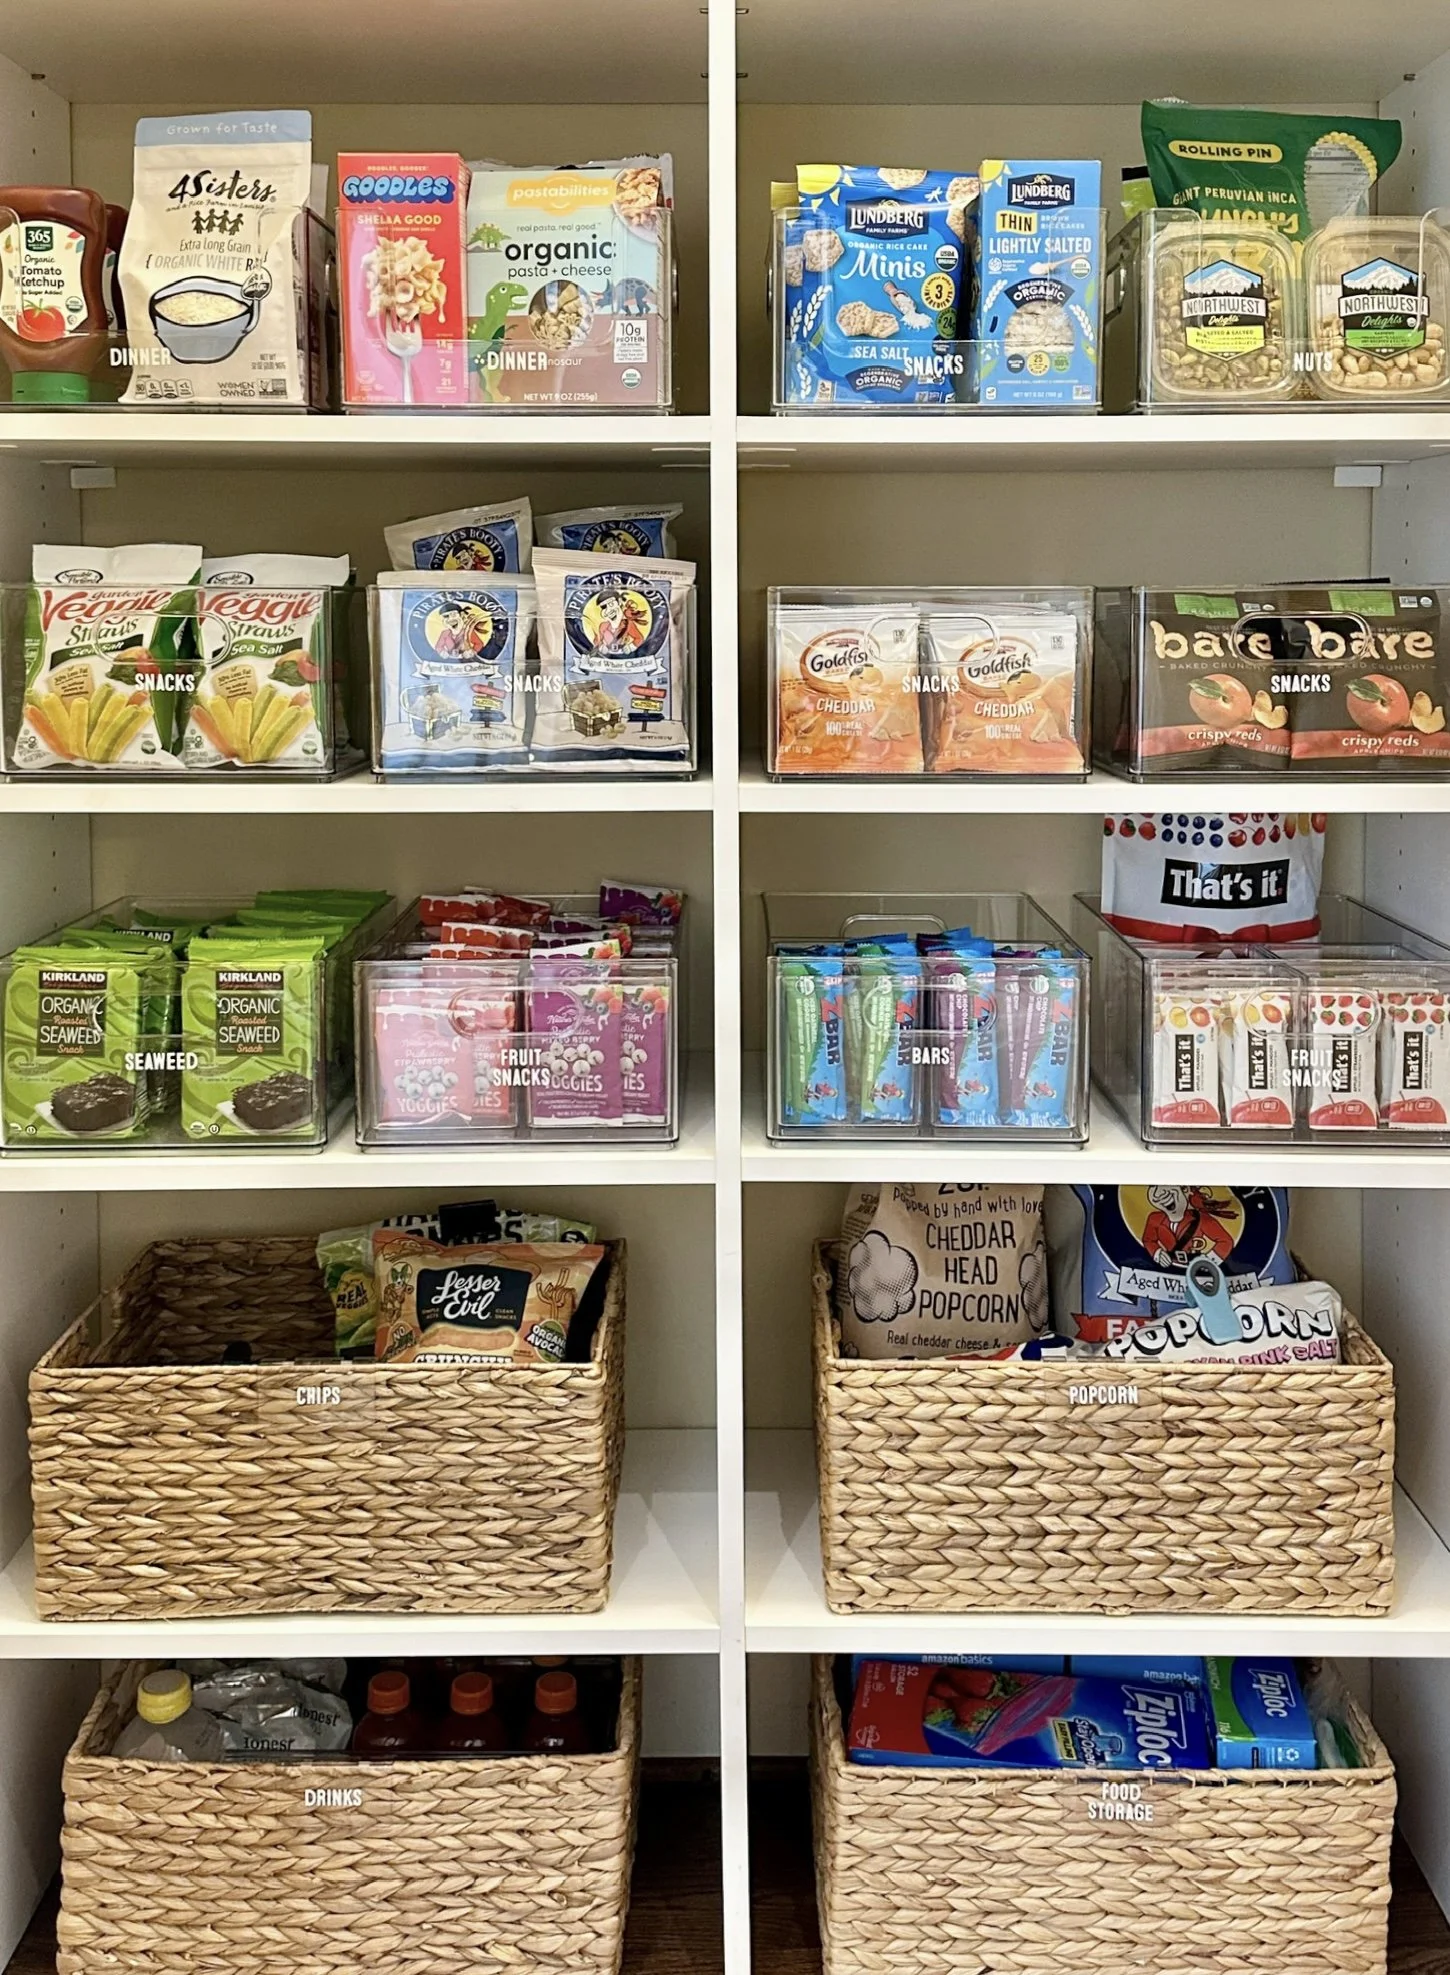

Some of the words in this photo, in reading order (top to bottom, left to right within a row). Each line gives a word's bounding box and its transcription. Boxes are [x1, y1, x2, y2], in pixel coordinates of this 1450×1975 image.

[167, 124, 210, 134] Grown
[216, 122, 239, 133] for
[242, 121, 278, 133] Taste
[1179, 145, 1242, 158] ROLLING
[1247, 147, 1272, 158] PIN
[342, 174, 455, 203] GOODLES
[513, 184, 610, 200] pastabilities
[1011, 184, 1071, 203] LUNDBERG
[1173, 186, 1201, 206] GIANT
[1205, 187, 1264, 204] PERUVIAN
[1268, 191, 1297, 204] INCA
[404, 214, 442, 225] GOOD
[516, 223, 532, 232] real
[558, 223, 574, 232] real
[850, 207, 924, 230] LUNDBERG
[1000, 214, 1033, 232] THIN
[28, 230, 51, 244] 365
[180, 238, 200, 252] Extra
[203, 238, 225, 252] Long
[227, 239, 252, 252] Grain
[848, 242, 884, 250] ORGANIC
[886, 242, 904, 250] RICE
[989, 238, 1042, 254] LIGHTLY
[1044, 238, 1092, 254] SALTED
[24, 254, 56, 264] Organic
[505, 234, 613, 266] organic
[21, 266, 62, 276] Tomato
[154, 254, 202, 269] ORGANIC
[206, 256, 243, 272] WHITE
[508, 266, 548, 279] pasta
[561, 264, 612, 276] cheese
[840, 250, 926, 280] Minis
[21, 276, 65, 289] Ketchup
[935, 284, 943, 300] 3
[620, 322, 642, 336] 10g
[1361, 314, 1402, 329] Delights
[110, 348, 172, 366] DINNER
[487, 352, 548, 370] DINNER
[854, 346, 878, 359] SEA
[880, 346, 910, 360] SALT
[1293, 352, 1333, 372] NUTS
[904, 354, 964, 377] SNACKS
[218, 381, 255, 389] WOMEN
[856, 376, 904, 386] ORGANIC
[220, 390, 256, 398] OWNED
[524, 393, 538, 401] NET
[540, 393, 552, 401] WT
[560, 393, 572, 401] OZ
[574, 392, 598, 402] (255g)
[470, 528, 504, 557] BOOTY
[620, 522, 650, 546] BOOTY
[568, 574, 622, 611] PIRATE'S
[43, 590, 172, 632] Veggie
[197, 591, 322, 627] Veggie
[412, 590, 464, 619] PIRATE'S
[222, 621, 296, 641] Straws
[1150, 620, 1274, 660] bare
[1304, 620, 1435, 660] bare
[968, 652, 1032, 678] Goldfish
[1170, 662, 1209, 670] BAKED
[1372, 662, 1426, 671] CRUNCHY
[134, 673, 195, 692] SNACKS
[504, 675, 561, 692] SNACKS
[902, 676, 960, 693] SNACKS
[1270, 674, 1331, 693] SNACKS
[816, 698, 876, 714] CHEDDAR
[974, 702, 1036, 718] CHEDDAR
[1188, 730, 1232, 742] crispy
[1236, 730, 1262, 742] reds
[1342, 737, 1384, 749] crispy
[1387, 736, 1420, 747] reds
[1170, 868, 1252, 901] That's
[42, 972, 106, 982] KIRKLAND
[218, 972, 282, 983] KIRKLAND
[41, 996, 104, 1014] ORGANIC
[219, 997, 281, 1014] ORGANIC
[53, 1015, 88, 1026] Roasted
[230, 1016, 268, 1025] Roasted
[1038, 996, 1048, 1034] CHOCOLATE
[40, 1026, 101, 1044] SEAWEED
[219, 1026, 280, 1044] SEAWEED
[572, 1035, 601, 1044] BERRY
[57, 1044, 84, 1054] Snack
[236, 1044, 264, 1053] Snack
[500, 1048, 542, 1066] FRUIT
[912, 1047, 949, 1065] BARS
[1290, 1048, 1333, 1067] FRUIT
[124, 1052, 198, 1070] SEAWEED
[1251, 1050, 1264, 1087] That's
[1406, 1050, 1420, 1088] That's
[492, 1068, 550, 1086] SNACKS
[1178, 1053, 1192, 1090] That's
[1282, 1068, 1342, 1088] SNACKS
[552, 1075, 603, 1092] OGGIES
[934, 1203, 949, 1218] by
[954, 1199, 982, 1218] hand
[987, 1196, 1016, 1213] with
[1022, 1199, 1044, 1214] love
[926, 1220, 1017, 1250] CHEDDAR
[944, 1256, 998, 1285] HEAD
[430, 1270, 501, 1305] Lesser
[1126, 1272, 1160, 1290] Aged
[338, 1280, 368, 1302] REAL
[336, 1296, 368, 1310] VEGGIES
[442, 1288, 496, 1320] Evil
[918, 1289, 1019, 1324] POPCORN
[392, 1326, 406, 1340] NO
[1106, 1301, 1333, 1357] POPORN
[887, 1330, 909, 1346] Real
[912, 1335, 951, 1349] cheddar
[955, 1338, 988, 1350] cheese
[992, 1338, 1001, 1349] &
[1295, 1338, 1338, 1358] SALT
[296, 1386, 340, 1406] CHIPS
[1068, 1384, 1139, 1404] POPCORN
[906, 1665, 918, 1676] 52
[896, 1664, 906, 1696] STORAGE
[1252, 1673, 1288, 1718] Ziploc
[1058, 1722, 1067, 1737] EASY
[1123, 1693, 1175, 1768] Ziploc
[1062, 1737, 1074, 1758] FILLING
[304, 1788, 362, 1807] DRINKS
[1102, 1782, 1142, 1800] FOOD
[1088, 1801, 1154, 1822] STORAGE
